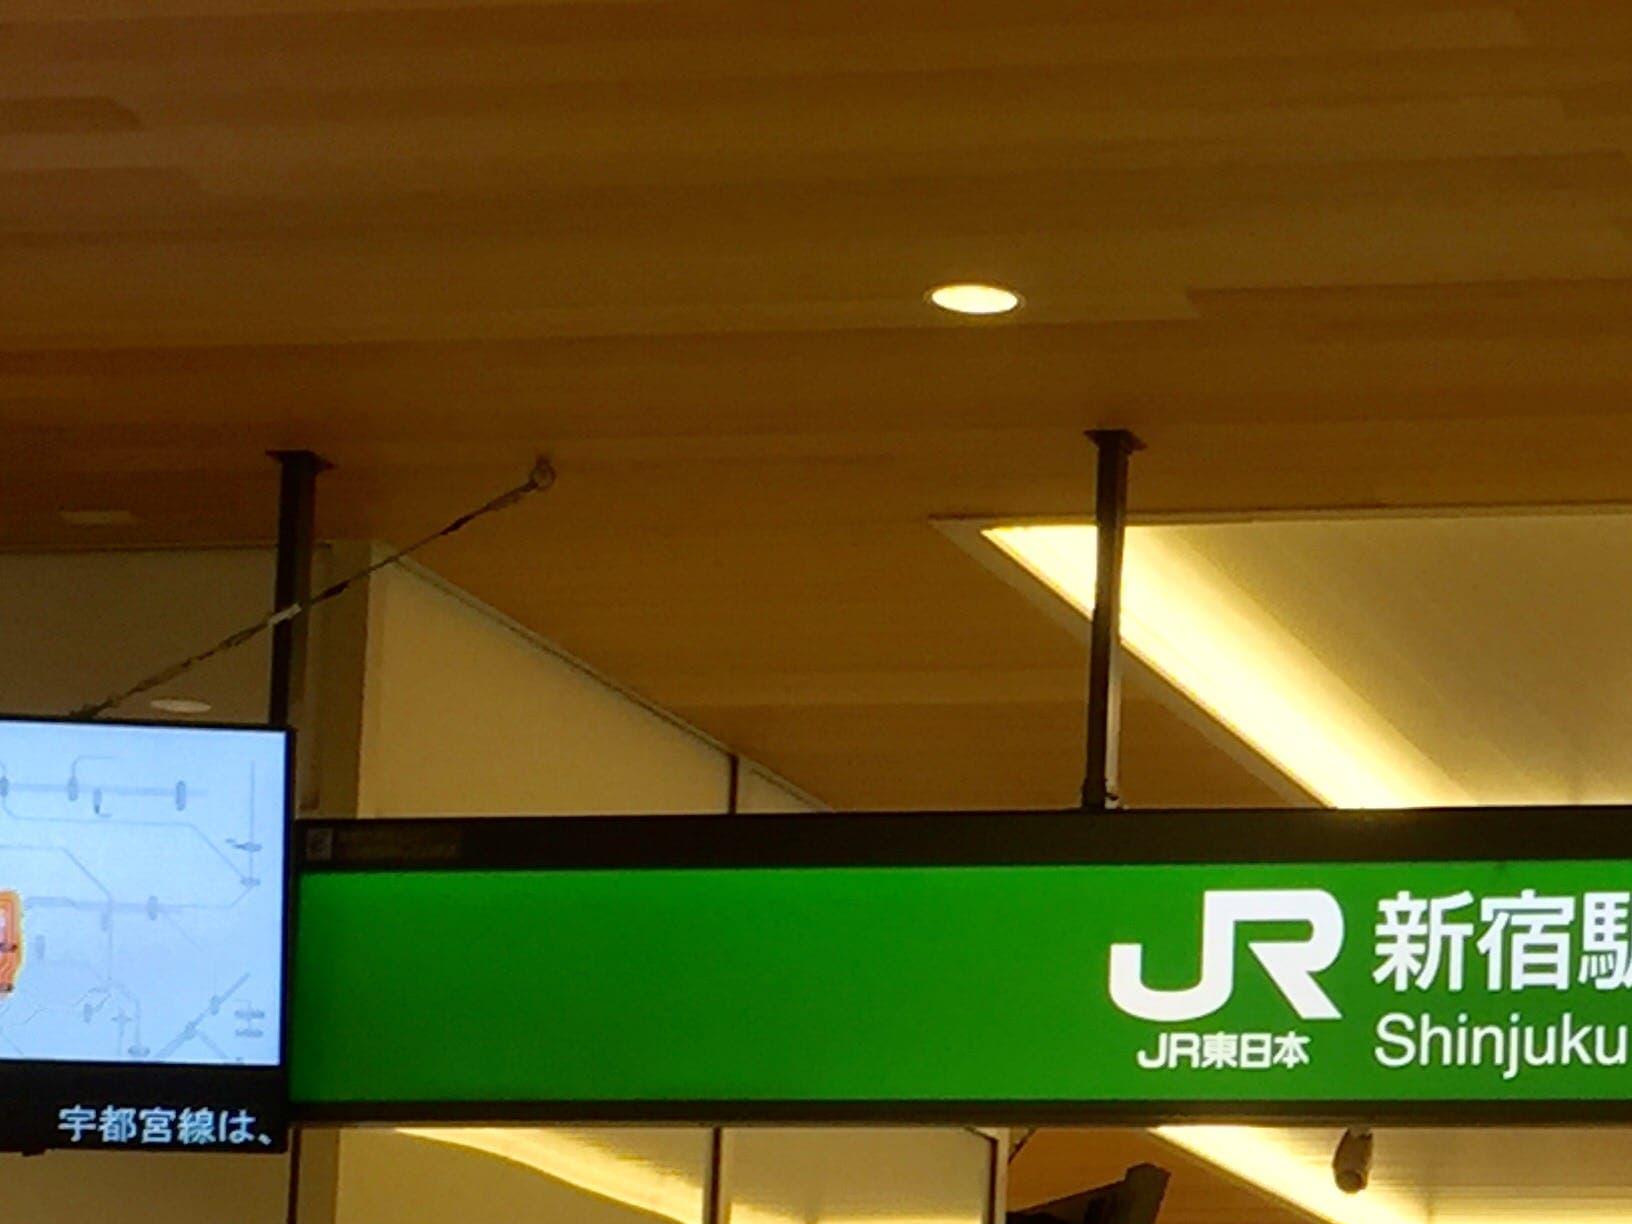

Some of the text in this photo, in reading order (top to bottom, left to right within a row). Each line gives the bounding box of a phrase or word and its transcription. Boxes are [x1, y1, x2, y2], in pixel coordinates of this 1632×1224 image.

[1108, 889, 1344, 1021] JR
[1137, 1032, 1311, 1070] JR東日本
[1374, 1011, 1627, 1080] Shinjuku
[58, 1105, 272, 1146] 宇都宮線は、
